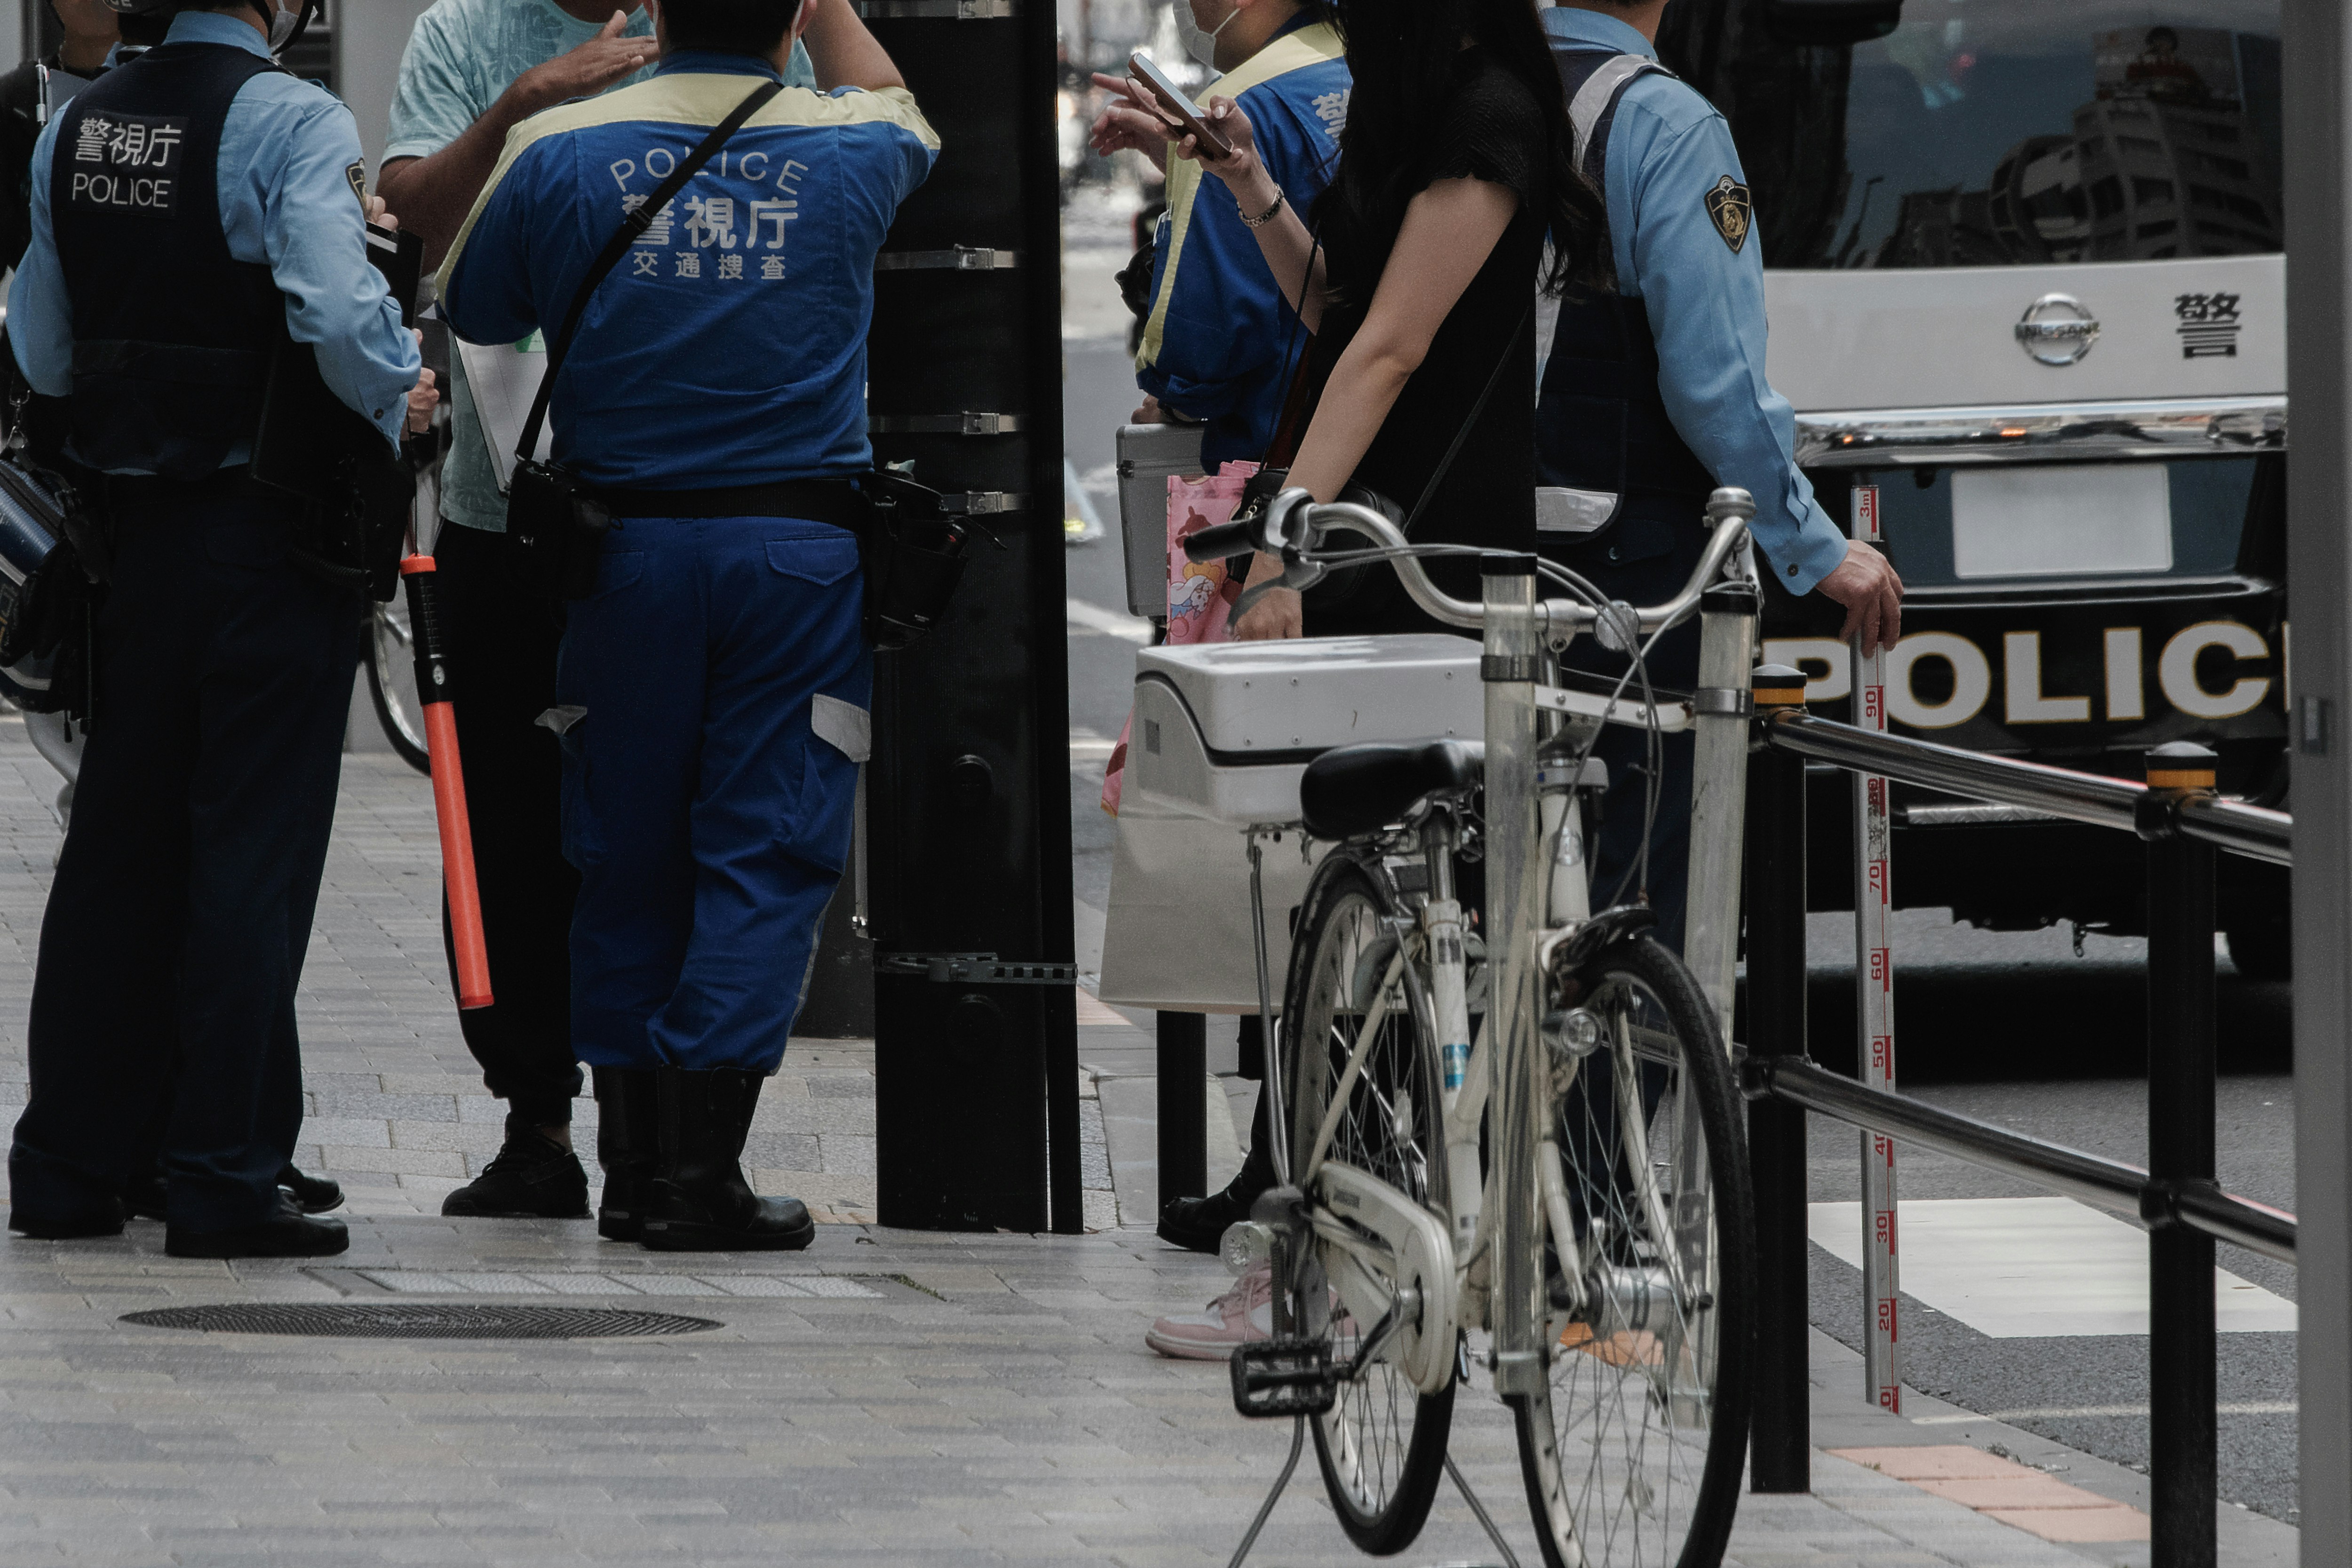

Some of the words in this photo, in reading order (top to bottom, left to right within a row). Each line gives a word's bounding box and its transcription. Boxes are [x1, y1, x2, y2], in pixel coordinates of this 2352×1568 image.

[75, 117, 183, 167] 警視庁
[72, 173, 171, 208] POLICE
[621, 194, 798, 249] 警視庁
[633, 250, 785, 280] 交通捜査
[2024, 324, 2094, 338] NISSAN
[2175, 292, 2241, 359] 警
[1859, 494, 1870, 517] 3m
[1762, 620, 2290, 730] POLIC
[1866, 691, 1876, 717] 90
[1869, 866, 1880, 893] 70
[1871, 953, 1882, 980] 60
[1873, 1042, 1883, 1068] 50
[1876, 1216, 1888, 1242] 30
[1878, 1304, 1890, 1330] 20
[1881, 1392, 1891, 1411] 0
